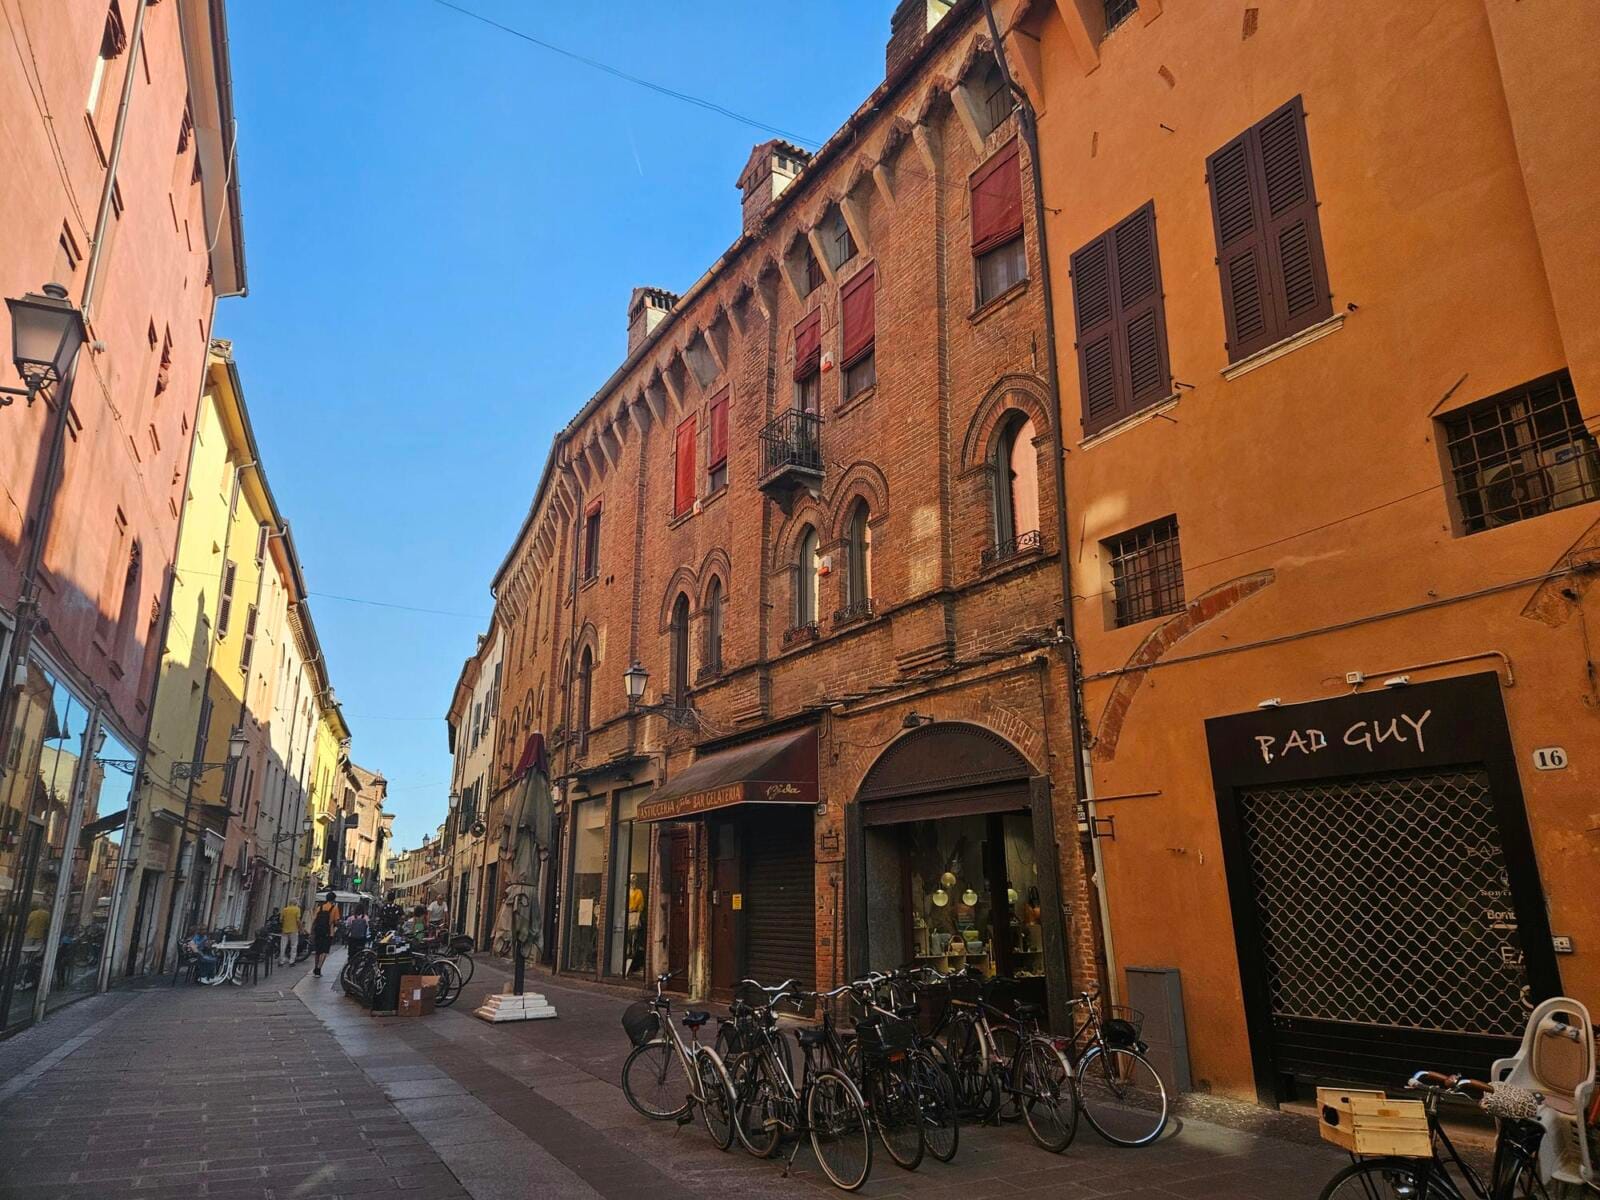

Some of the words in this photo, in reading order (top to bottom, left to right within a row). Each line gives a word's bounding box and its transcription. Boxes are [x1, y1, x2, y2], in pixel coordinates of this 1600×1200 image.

[1342, 709, 1432, 753] GUY
[1539, 750, 1563, 767] 16
[706, 785, 741, 807] GELATERIA
